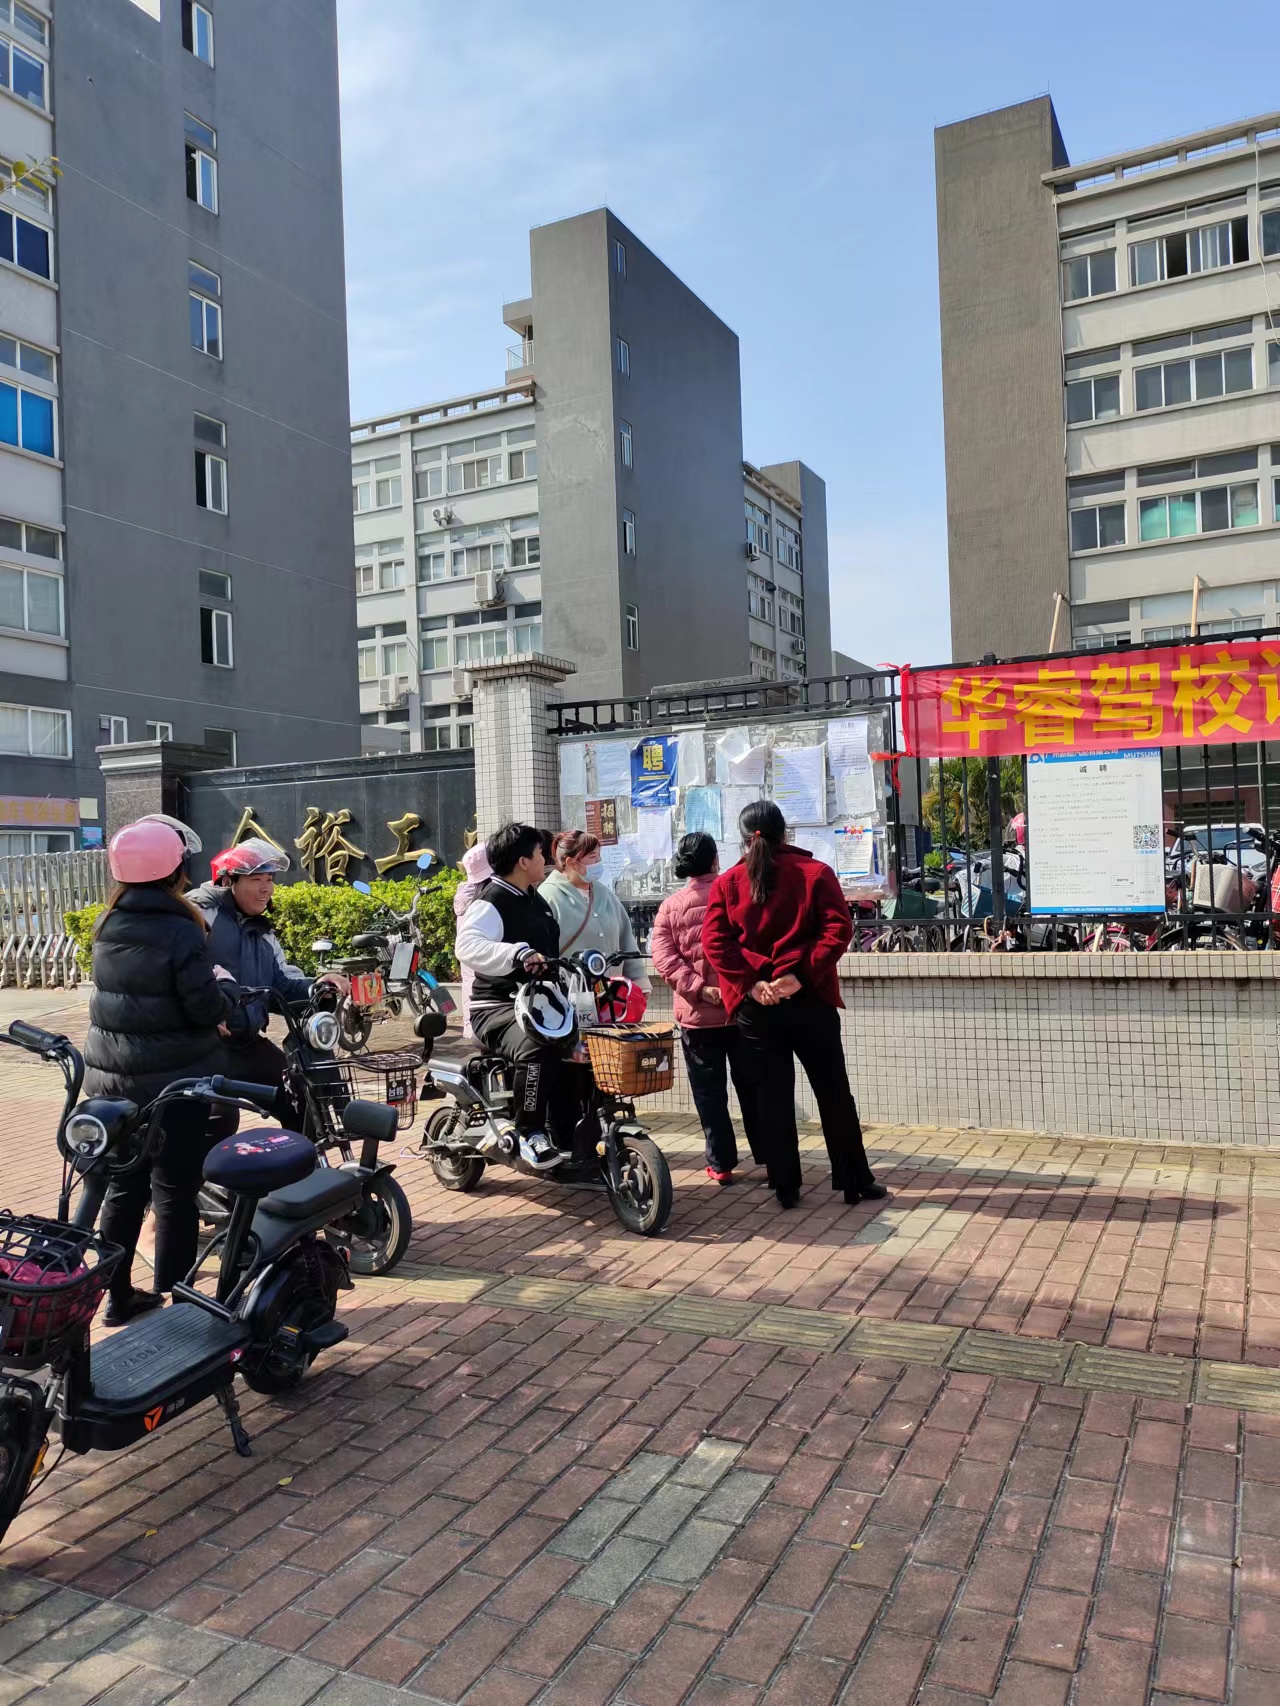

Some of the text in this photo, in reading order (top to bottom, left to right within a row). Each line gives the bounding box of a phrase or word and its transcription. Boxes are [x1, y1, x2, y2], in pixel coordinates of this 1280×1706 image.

[643, 744, 664, 771] 聘
[1123, 751, 1160, 759] MUTSUMI
[600, 803, 615, 836] 招聘
[578, 1013, 593, 1023] NFC
[527, 1065, 538, 1085] WHAT
[526, 1086, 536, 1097] TO
[119, 1343, 166, 1369] YADEA
